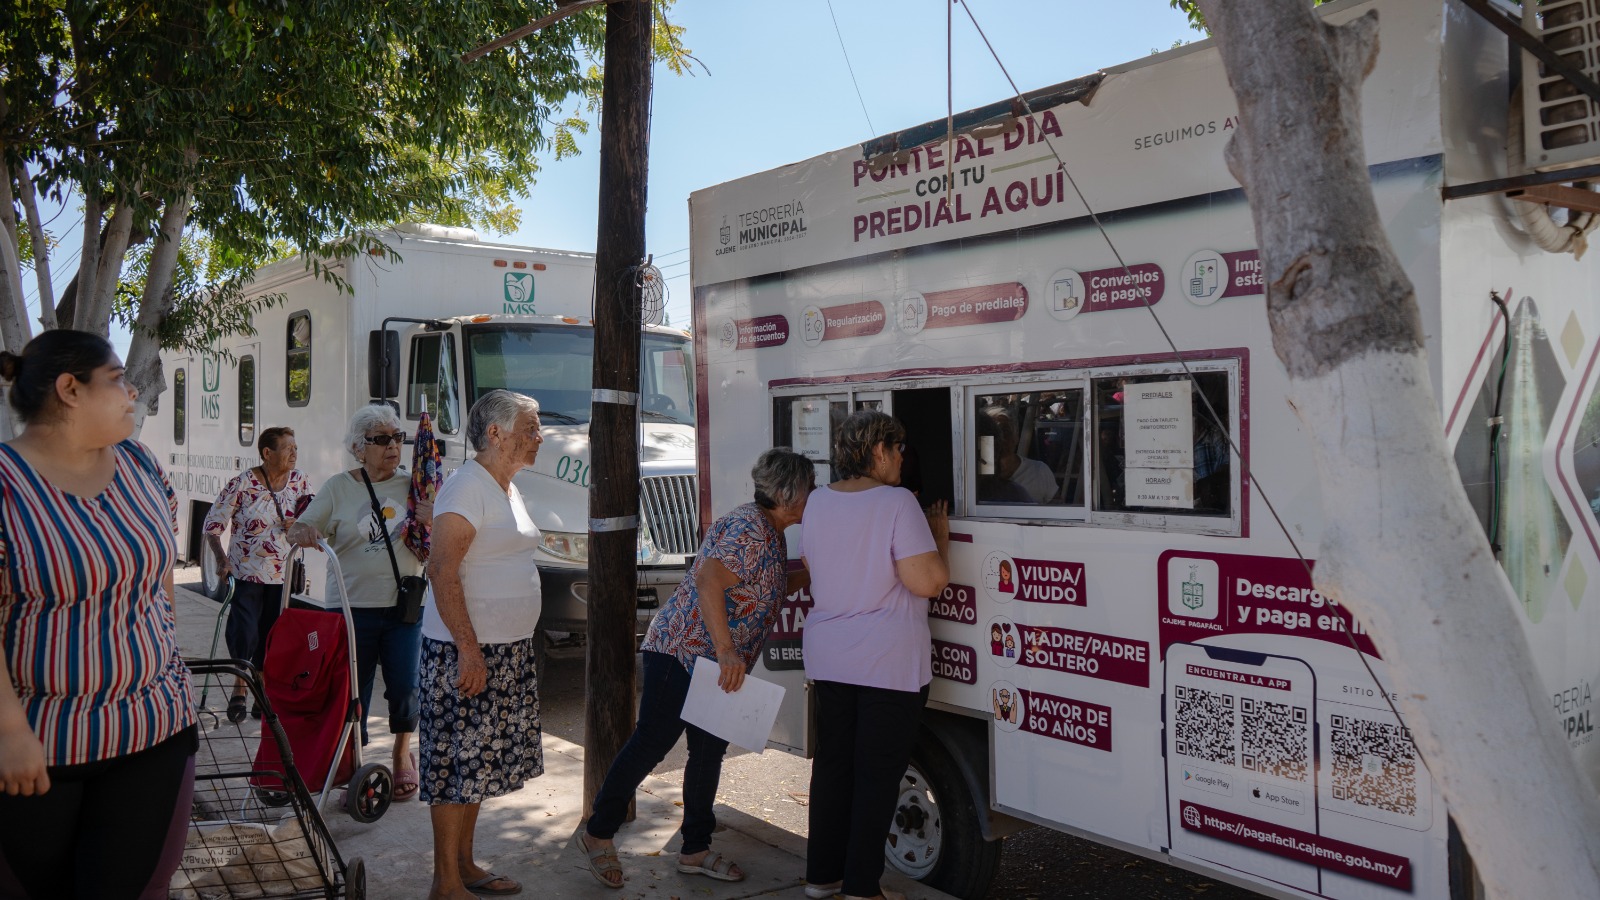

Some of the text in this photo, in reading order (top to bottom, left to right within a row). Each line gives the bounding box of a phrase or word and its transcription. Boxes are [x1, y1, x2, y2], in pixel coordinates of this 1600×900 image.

[1134, 121, 1217, 150] SEGUIMOS
[915, 164, 985, 197] CON TU
[739, 198, 805, 228] TESORERÍA
[853, 162, 1067, 243] PREDIAL AQUÍ
[739, 217, 807, 245] MUNICIPAL
[715, 245, 737, 256] CAJEME
[1091, 269, 1159, 290] Convenios
[1091, 284, 1152, 303] de pagos
[503, 302, 536, 315] IMSS
[931, 296, 1025, 318] Pago de prediales
[739, 322, 777, 336] Información
[827, 311, 883, 329] Regularización
[739, 331, 786, 344] de descuentos
[1141, 391, 1173, 399] PREDIALES
[201, 393, 220, 420] IMSS
[1021, 565, 1082, 585] VIUDA/
[1021, 583, 1077, 602] VIUDO
[928, 600, 975, 621] ADA/O
[1237, 605, 1251, 624] y
[1256, 606, 1311, 630] paga
[1317, 614, 1346, 633] en
[1162, 617, 1224, 632] CAJEME PAGAFÁCIL
[769, 646, 804, 661] SI ERE
[942, 646, 970, 664] CON
[1024, 630, 1147, 663] MADRE/PADRE
[1025, 649, 1099, 674] SOLTERO
[1187, 665, 1288, 690] ENCUENTRA LA APP
[1342, 685, 1374, 697] SITIO
[1028, 696, 1109, 728] MAYOR DE
[1029, 714, 1097, 744] 60 AÑOS
[1195, 773, 1230, 791] Google Play
[1265, 791, 1300, 807] App Store
[1204, 814, 1403, 879] https://pagafacil.cajeme.gob.mx/
